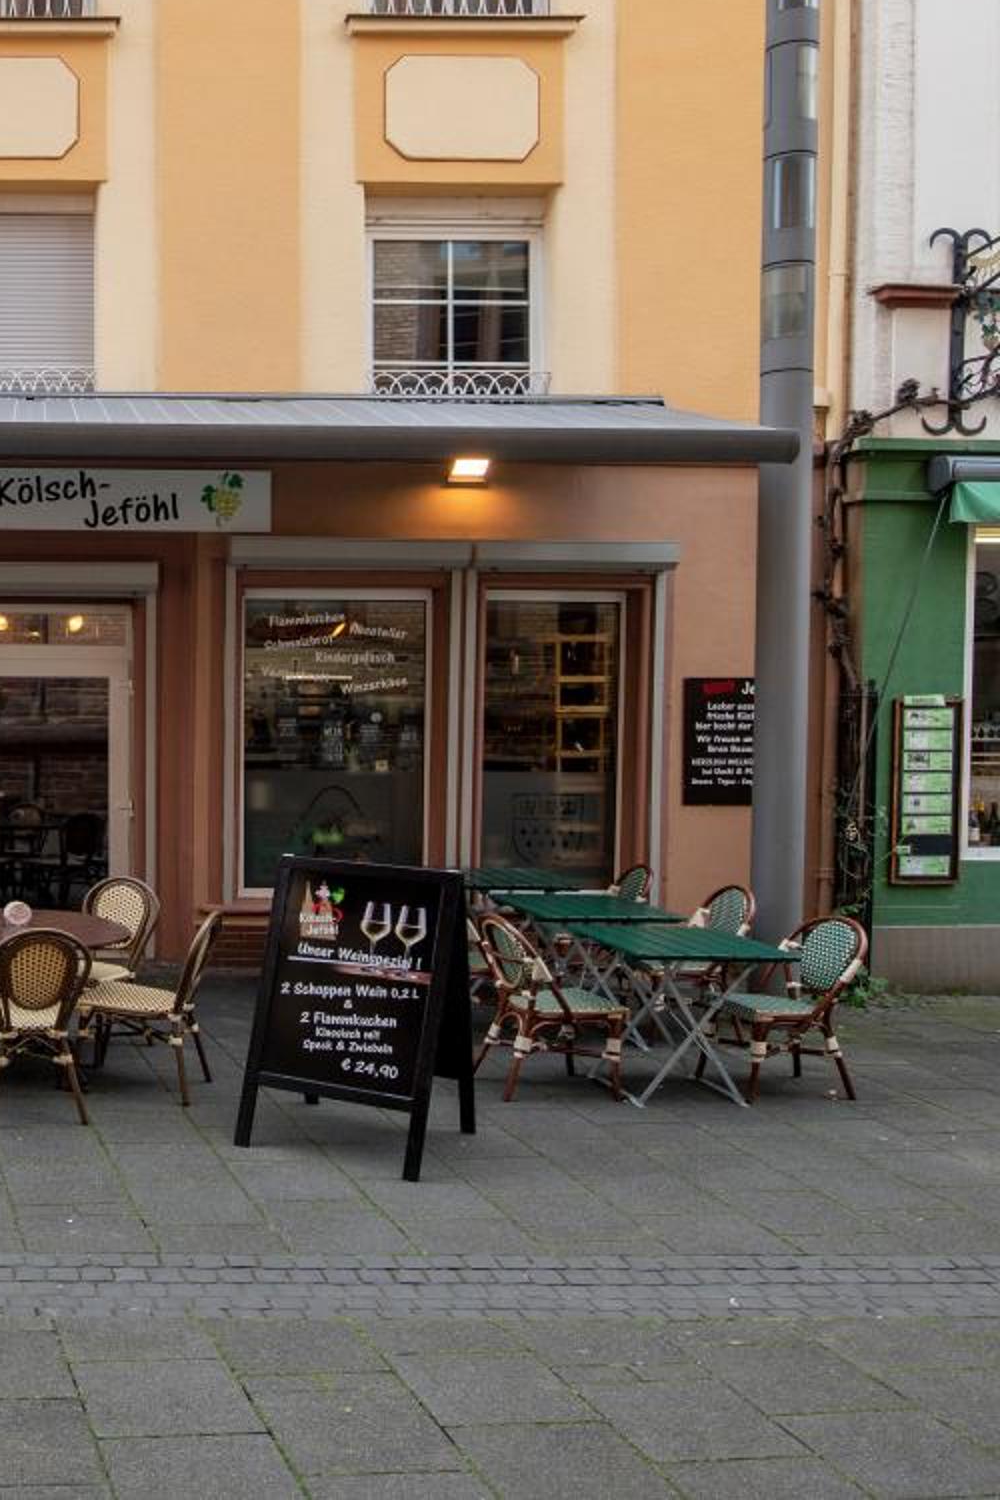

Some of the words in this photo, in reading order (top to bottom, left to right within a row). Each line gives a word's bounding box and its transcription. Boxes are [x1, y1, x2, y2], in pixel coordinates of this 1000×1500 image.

[83, 494, 180, 528] Jeföhl
[315, 651, 396, 665] Rindergulasch
[297, 942, 334, 959] Unser
[281, 981, 291, 994] 2
[294, 981, 351, 1000] Schoppen
[355, 983, 387, 998] Wein
[343, 999, 353, 1009] &
[300, 1011, 310, 1023] 2
[313, 1011, 397, 1028] Flammkuchen
[302, 1038, 333, 1052] Speck
[335, 1041, 345, 1051] &
[348, 1041, 393, 1055] Zwiebeln
[341, 1057, 351, 1071] €
[354, 1059, 399, 1079] 24,90
